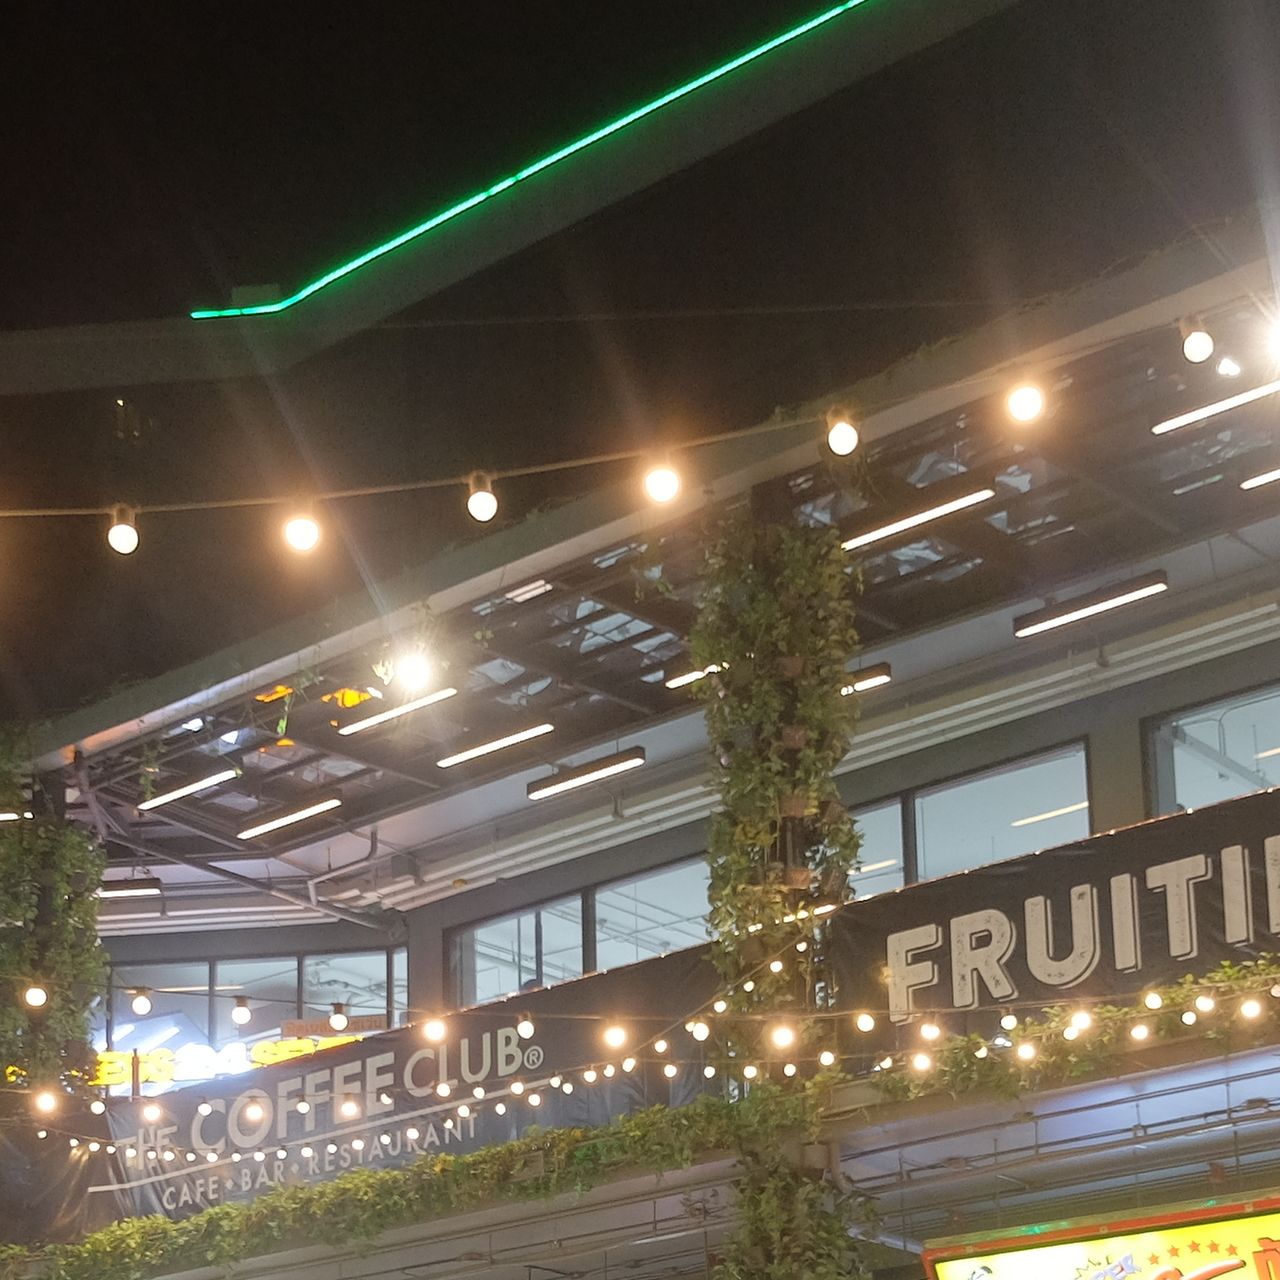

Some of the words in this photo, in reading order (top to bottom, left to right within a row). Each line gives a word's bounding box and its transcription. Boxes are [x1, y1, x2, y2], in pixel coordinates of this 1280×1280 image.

[190, 1052, 396, 1158] COFFEE
[162, 1178, 218, 1211] CAFE
[241, 1161, 286, 1192] BAR
[308, 1113, 478, 1176] RESTAURANT
